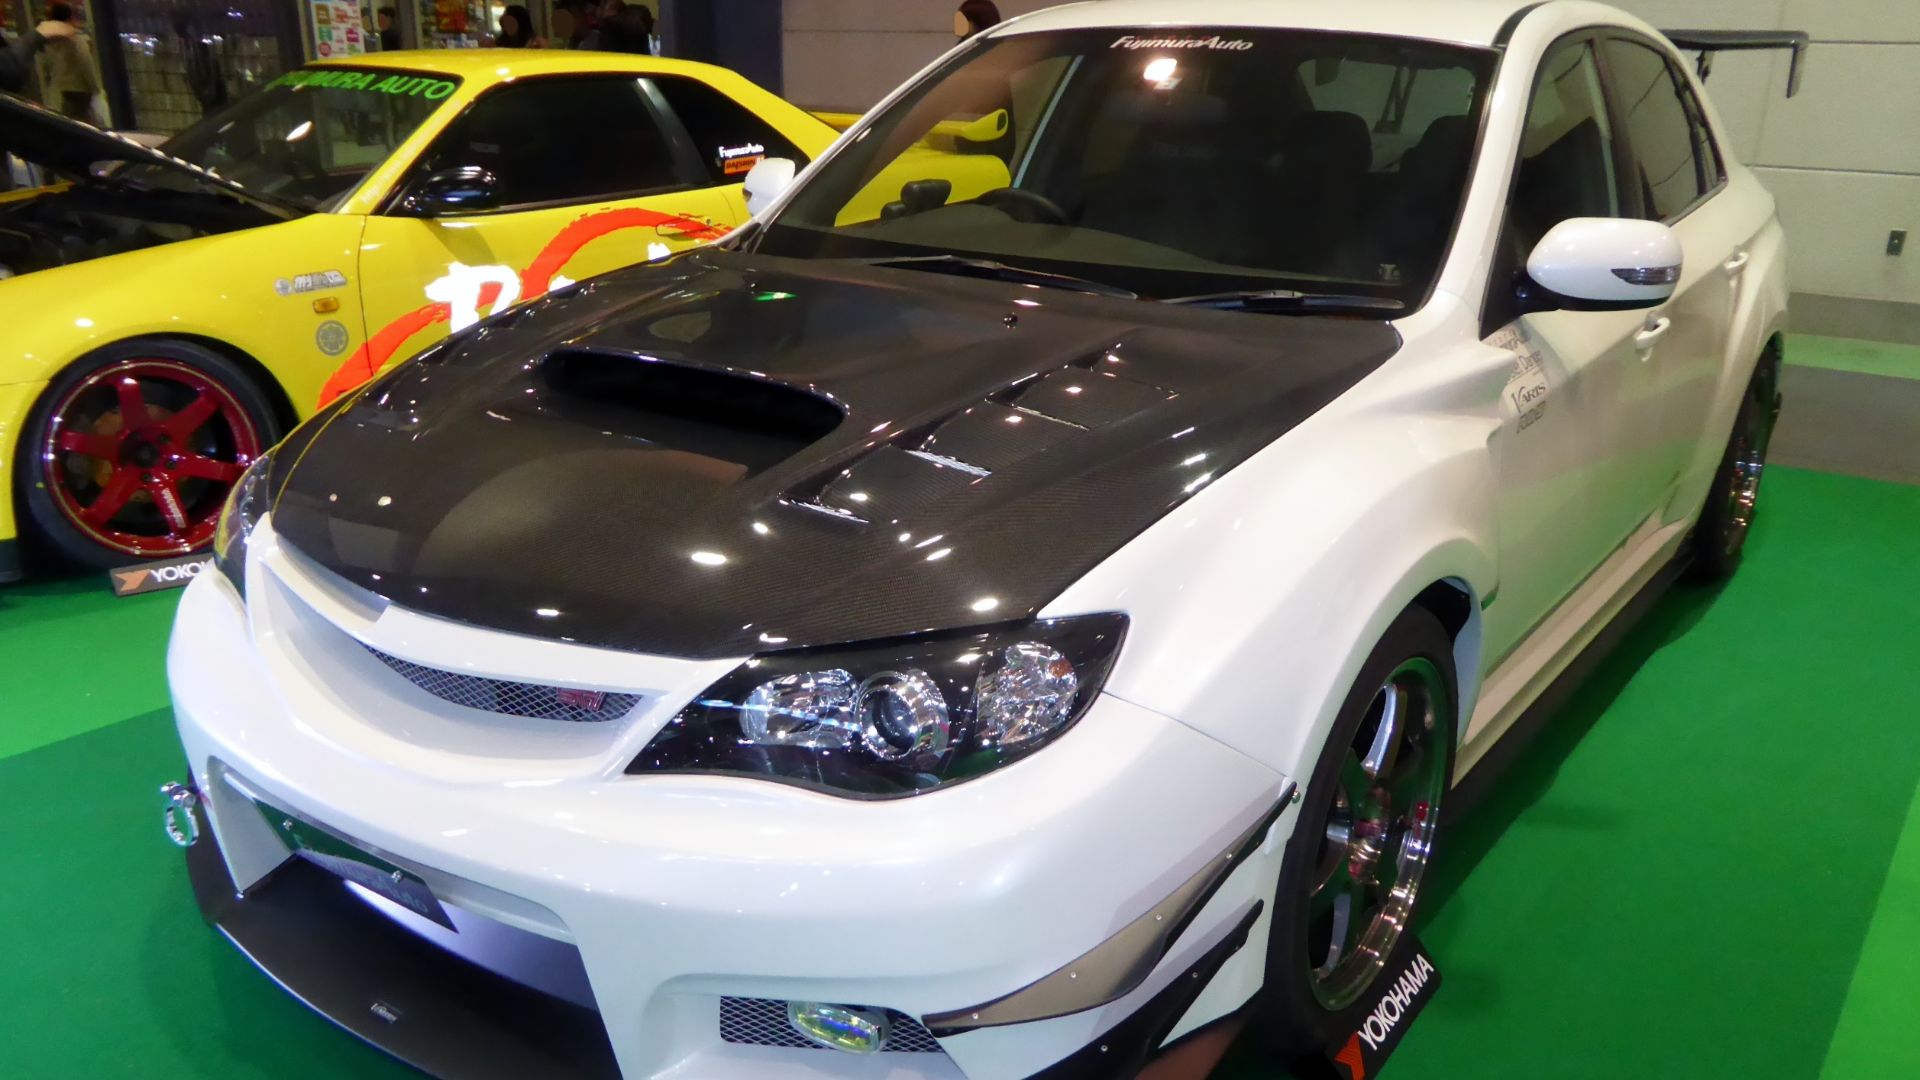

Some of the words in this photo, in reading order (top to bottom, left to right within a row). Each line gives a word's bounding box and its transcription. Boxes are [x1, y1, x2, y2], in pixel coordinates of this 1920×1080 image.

[263, 70, 375, 92] MURA
[369, 74, 456, 100] AUTO
[1357, 953, 1435, 1051] YOKOHAMA
